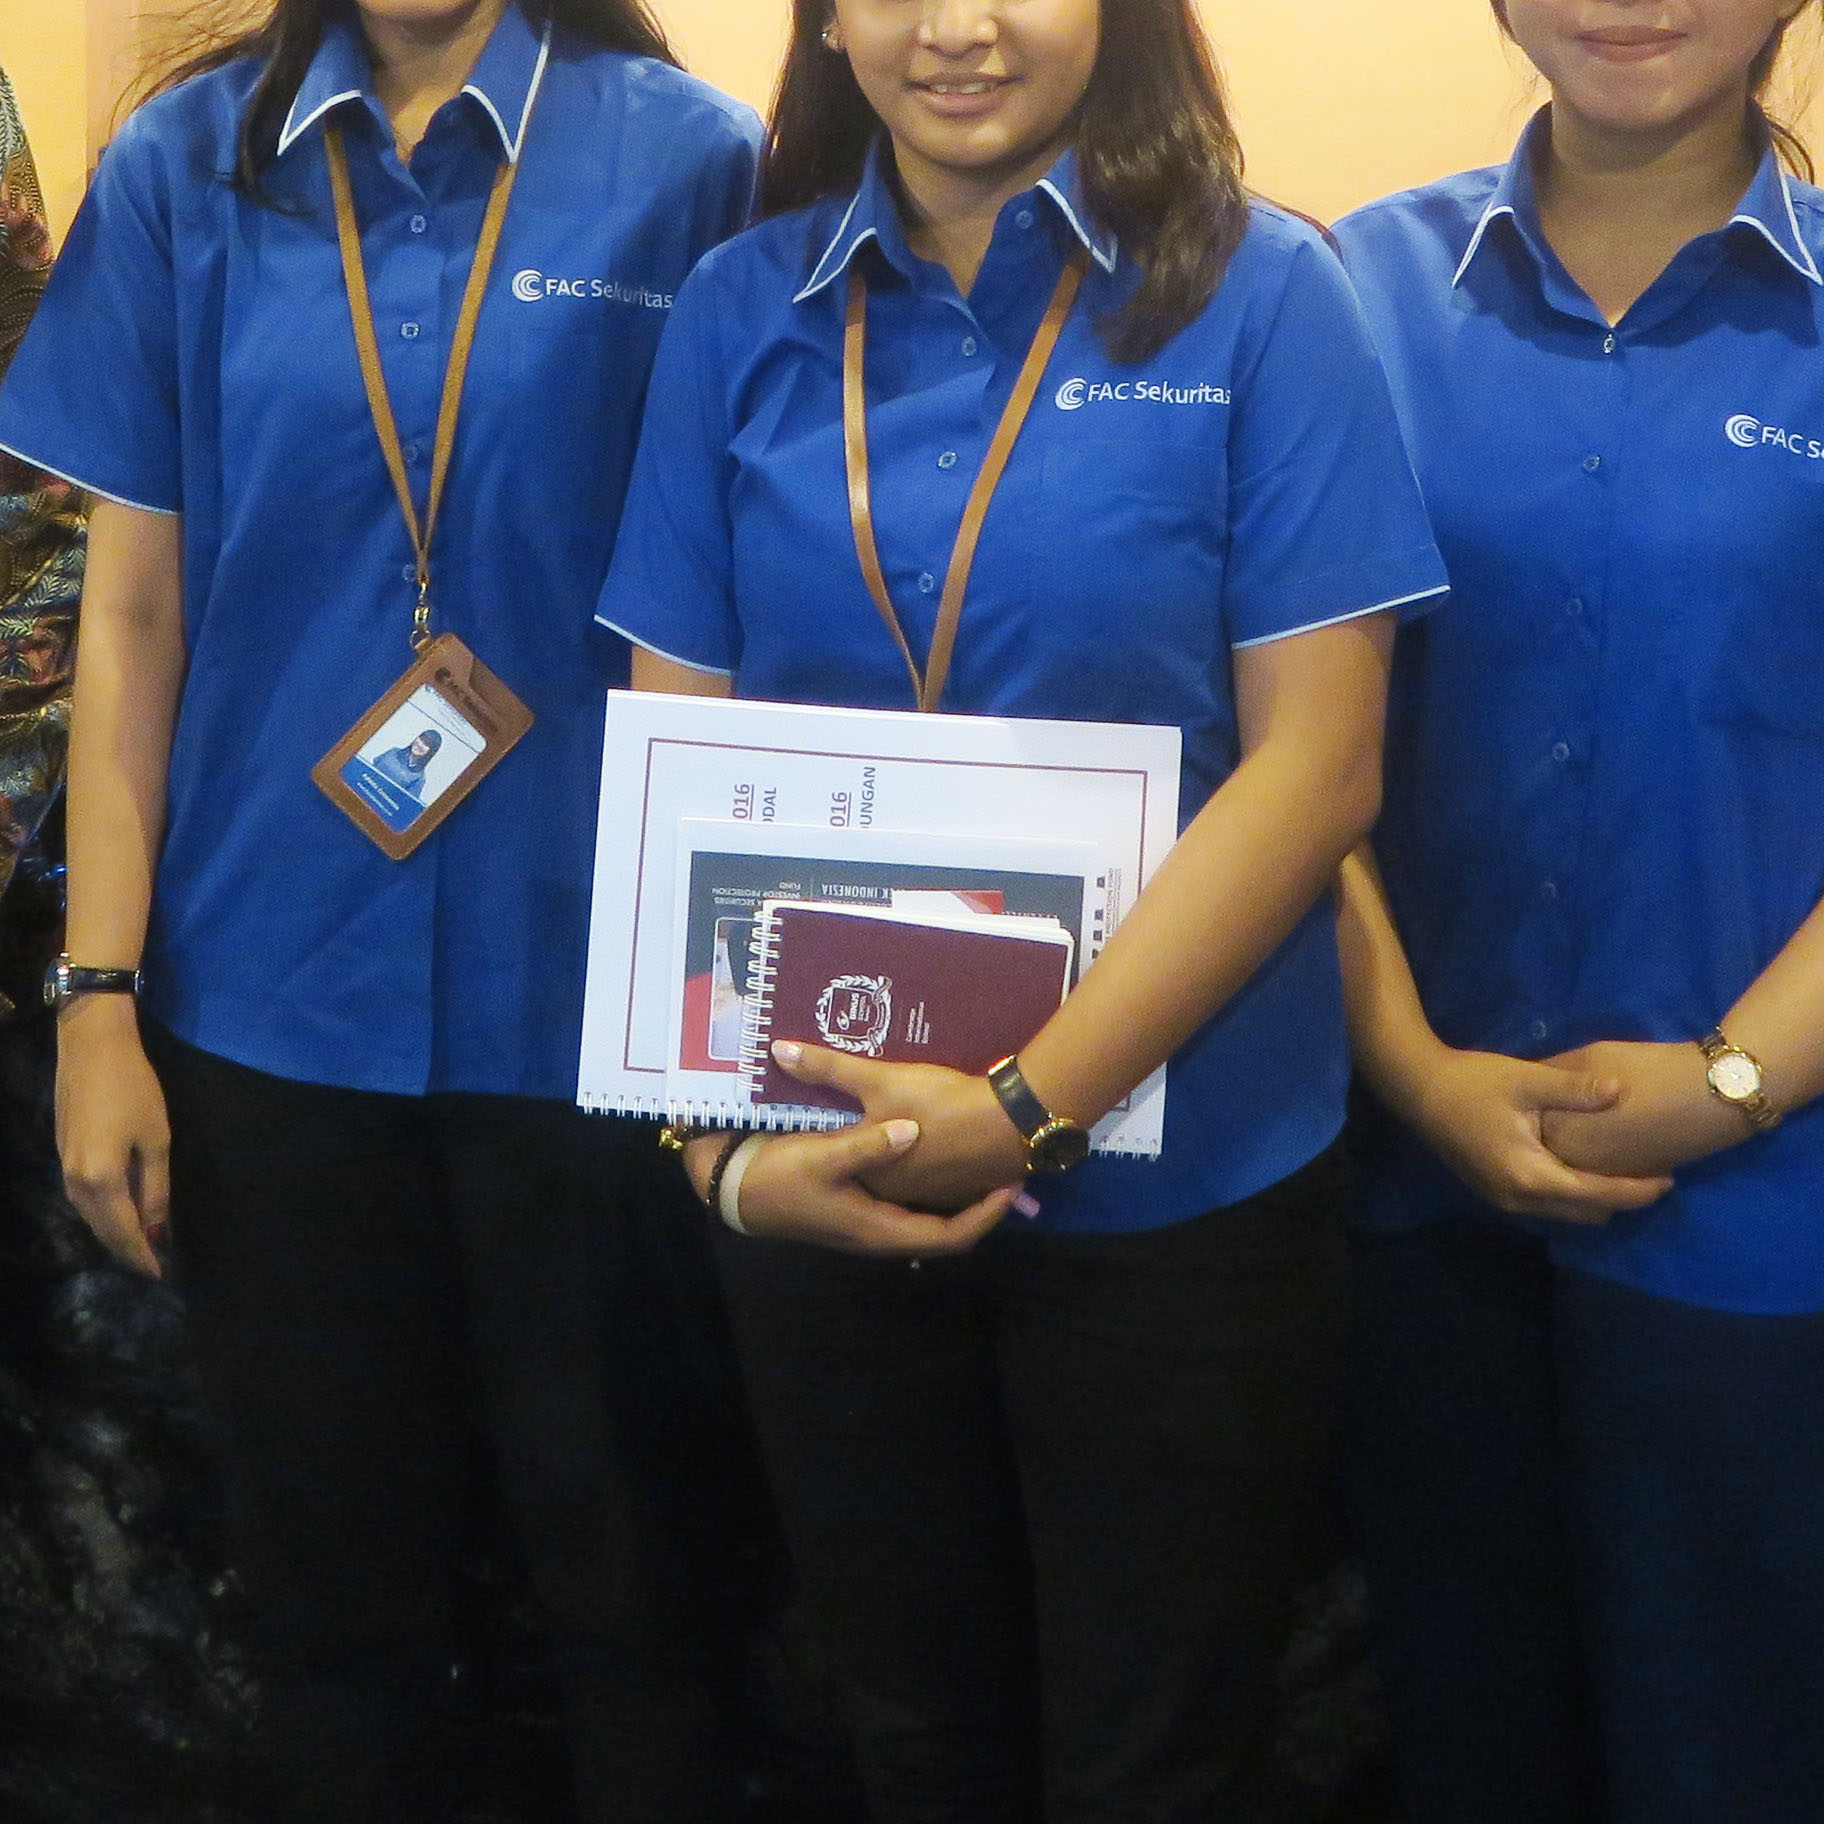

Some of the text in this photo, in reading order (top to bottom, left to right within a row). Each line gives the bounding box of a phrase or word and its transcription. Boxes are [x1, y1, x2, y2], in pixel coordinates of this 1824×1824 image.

[544, 278, 674, 309] FAC Sekuritas
[1086, 380, 1233, 405] FAC Sekuritas
[1760, 425, 1804, 455] FAC
[859, 766, 876, 829] UNGAN
[821, 883, 878, 898] INDONESIA
